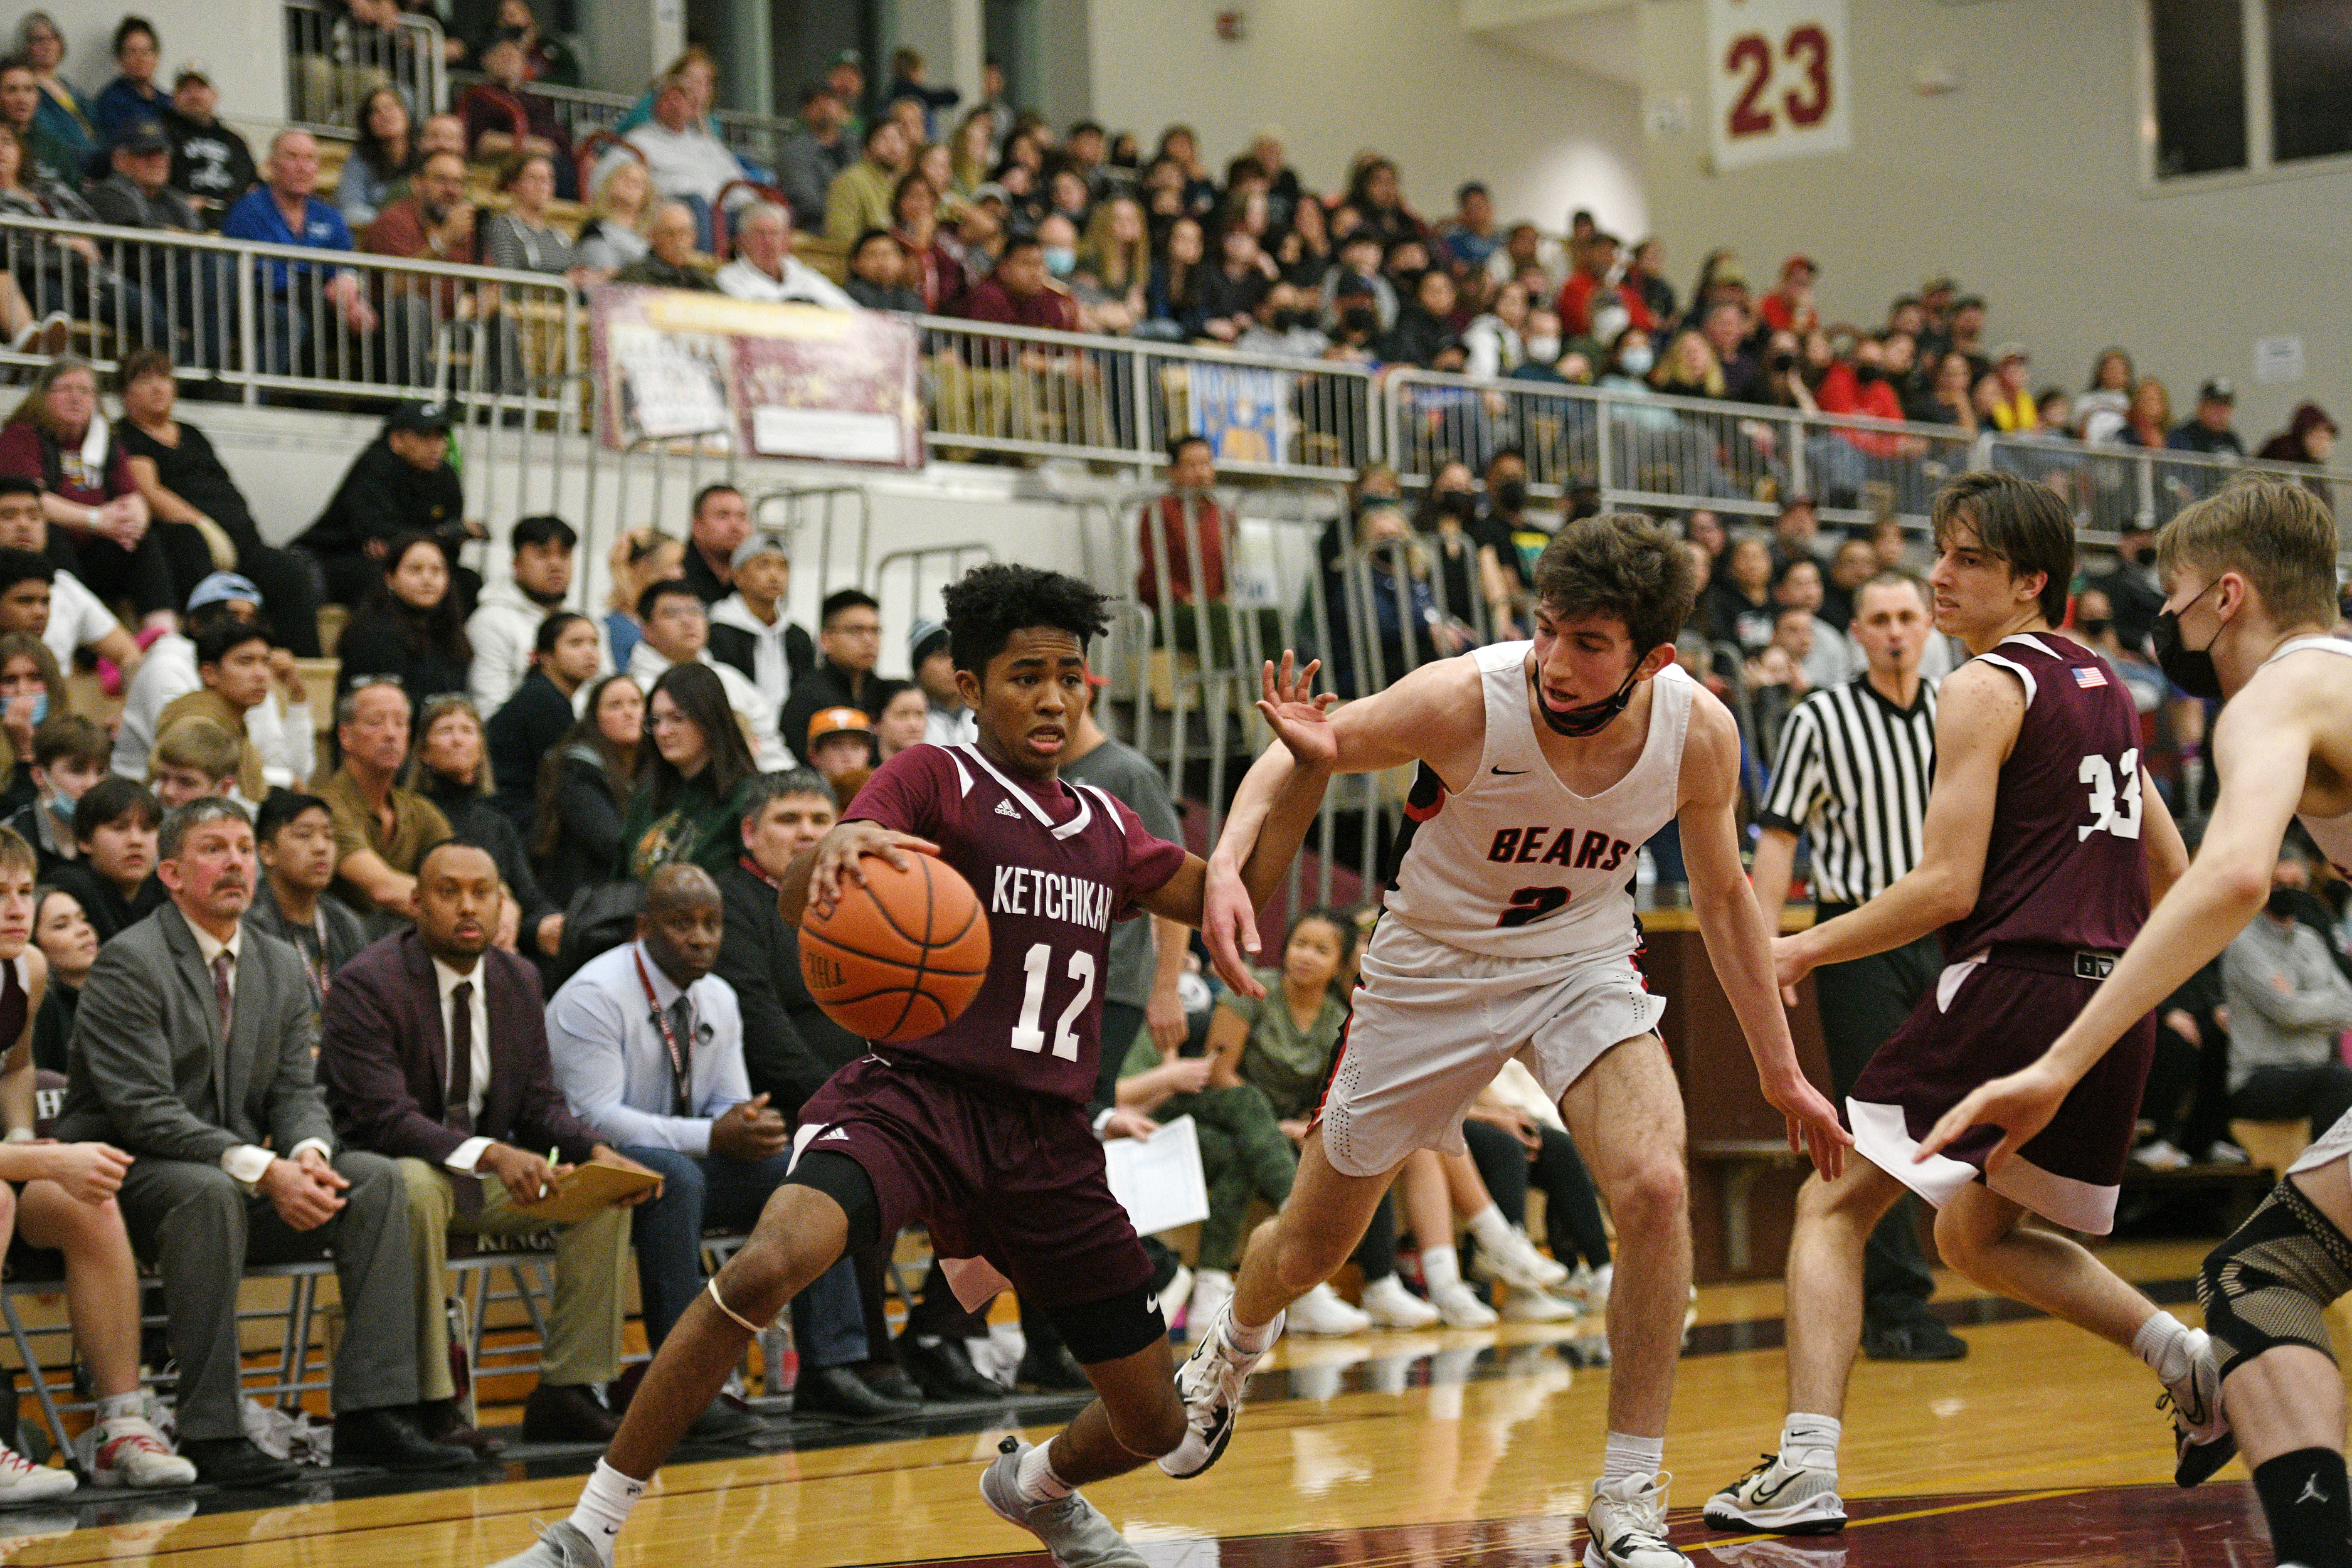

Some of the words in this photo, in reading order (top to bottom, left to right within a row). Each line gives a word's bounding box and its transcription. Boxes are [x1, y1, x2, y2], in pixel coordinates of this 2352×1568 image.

[1727, 26, 1829, 135] 23
[994, 808, 1021, 819] adidas
[2078, 748, 2143, 842] 33
[1487, 827, 1631, 871] BEARS
[992, 866, 1112, 933] KETCHIKAN
[1496, 886, 1571, 926] 2
[1011, 943, 1095, 1062] 12
